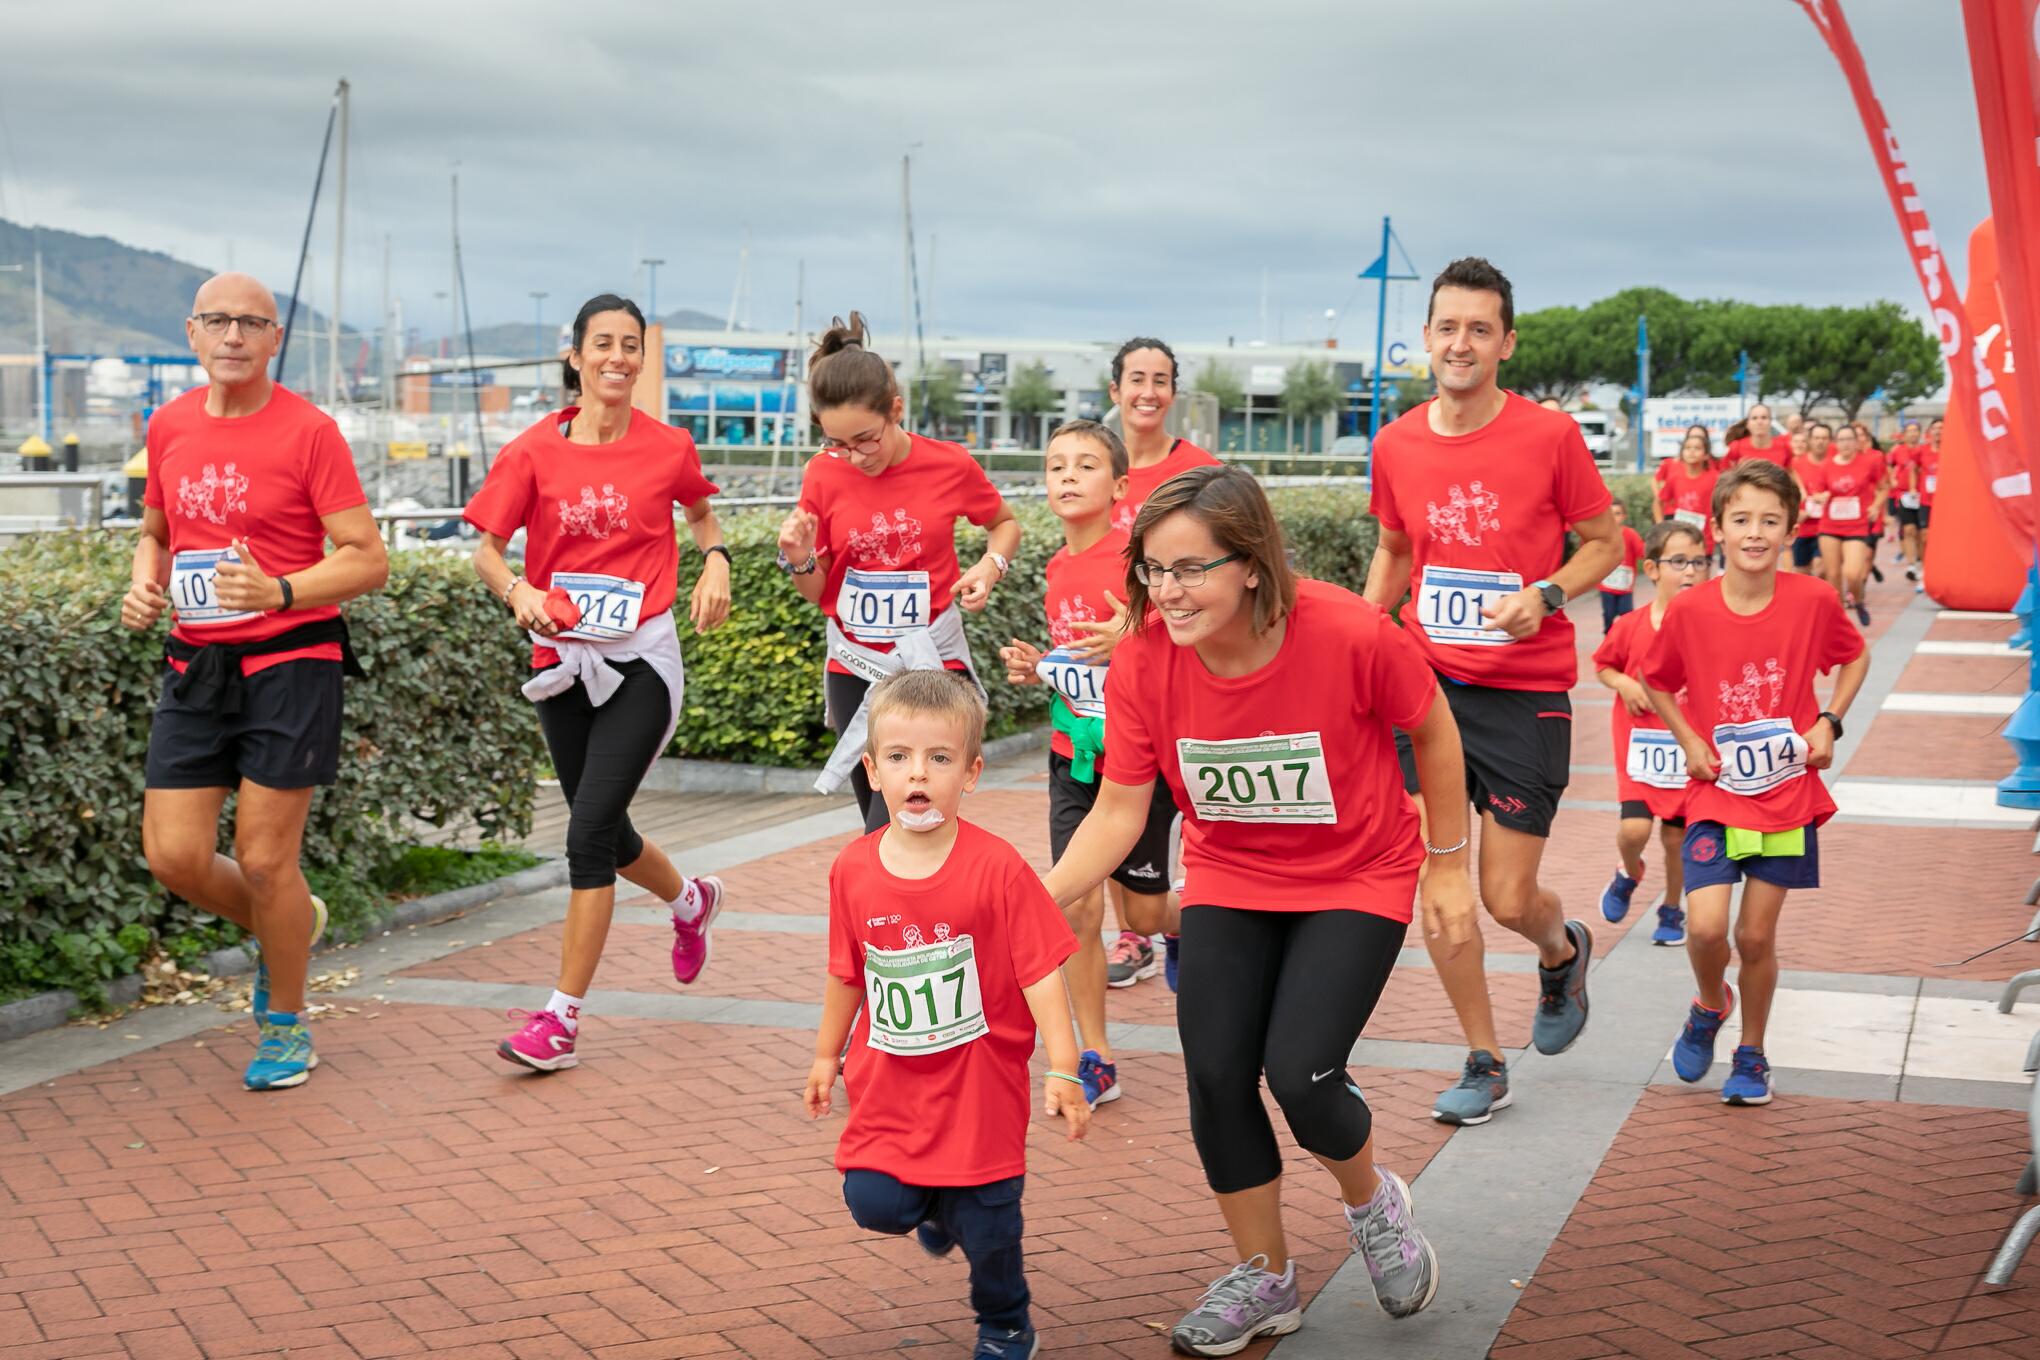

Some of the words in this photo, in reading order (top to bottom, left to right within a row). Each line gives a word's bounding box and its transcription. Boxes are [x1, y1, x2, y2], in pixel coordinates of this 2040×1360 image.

[1388, 342, 1407, 366] C
[179, 573, 218, 606] 10
[575, 593, 629, 627] 014
[850, 590, 919, 624] 1014
[1430, 589, 1508, 626] 101
[840, 649, 866, 670] GOOD
[868, 666, 887, 680] VIB
[1048, 666, 1105, 700] 101
[1640, 747, 1687, 773] 101
[1198, 762, 1310, 803] 2017
[873, 966, 966, 1031] 2017
